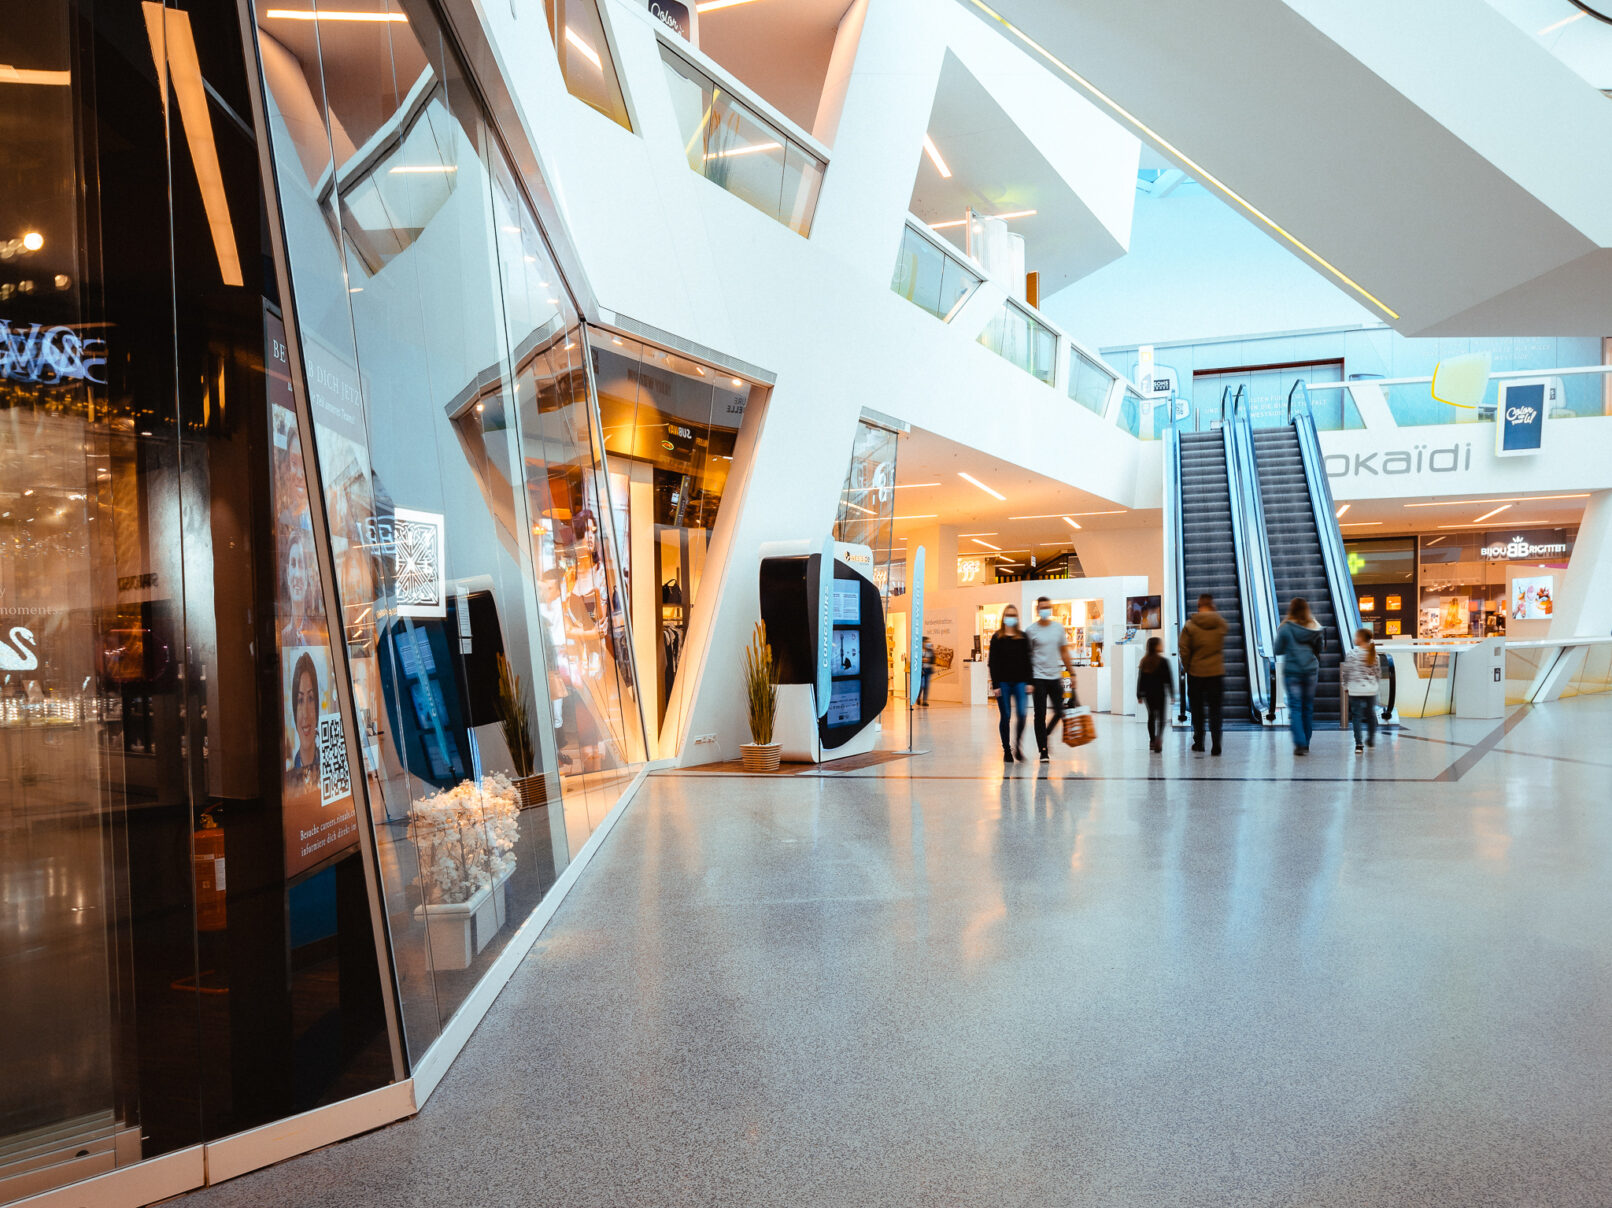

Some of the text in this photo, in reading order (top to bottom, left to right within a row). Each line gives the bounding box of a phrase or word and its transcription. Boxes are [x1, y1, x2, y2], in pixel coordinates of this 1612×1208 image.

[1506, 405, 1534, 421] Color
[1323, 442, 1472, 478] okaïdi
[1480, 546, 1507, 558] BIJOU
[822, 583, 830, 669] CONCOURS
[300, 823, 320, 841] Besuche
[326, 831, 337, 844] dich
